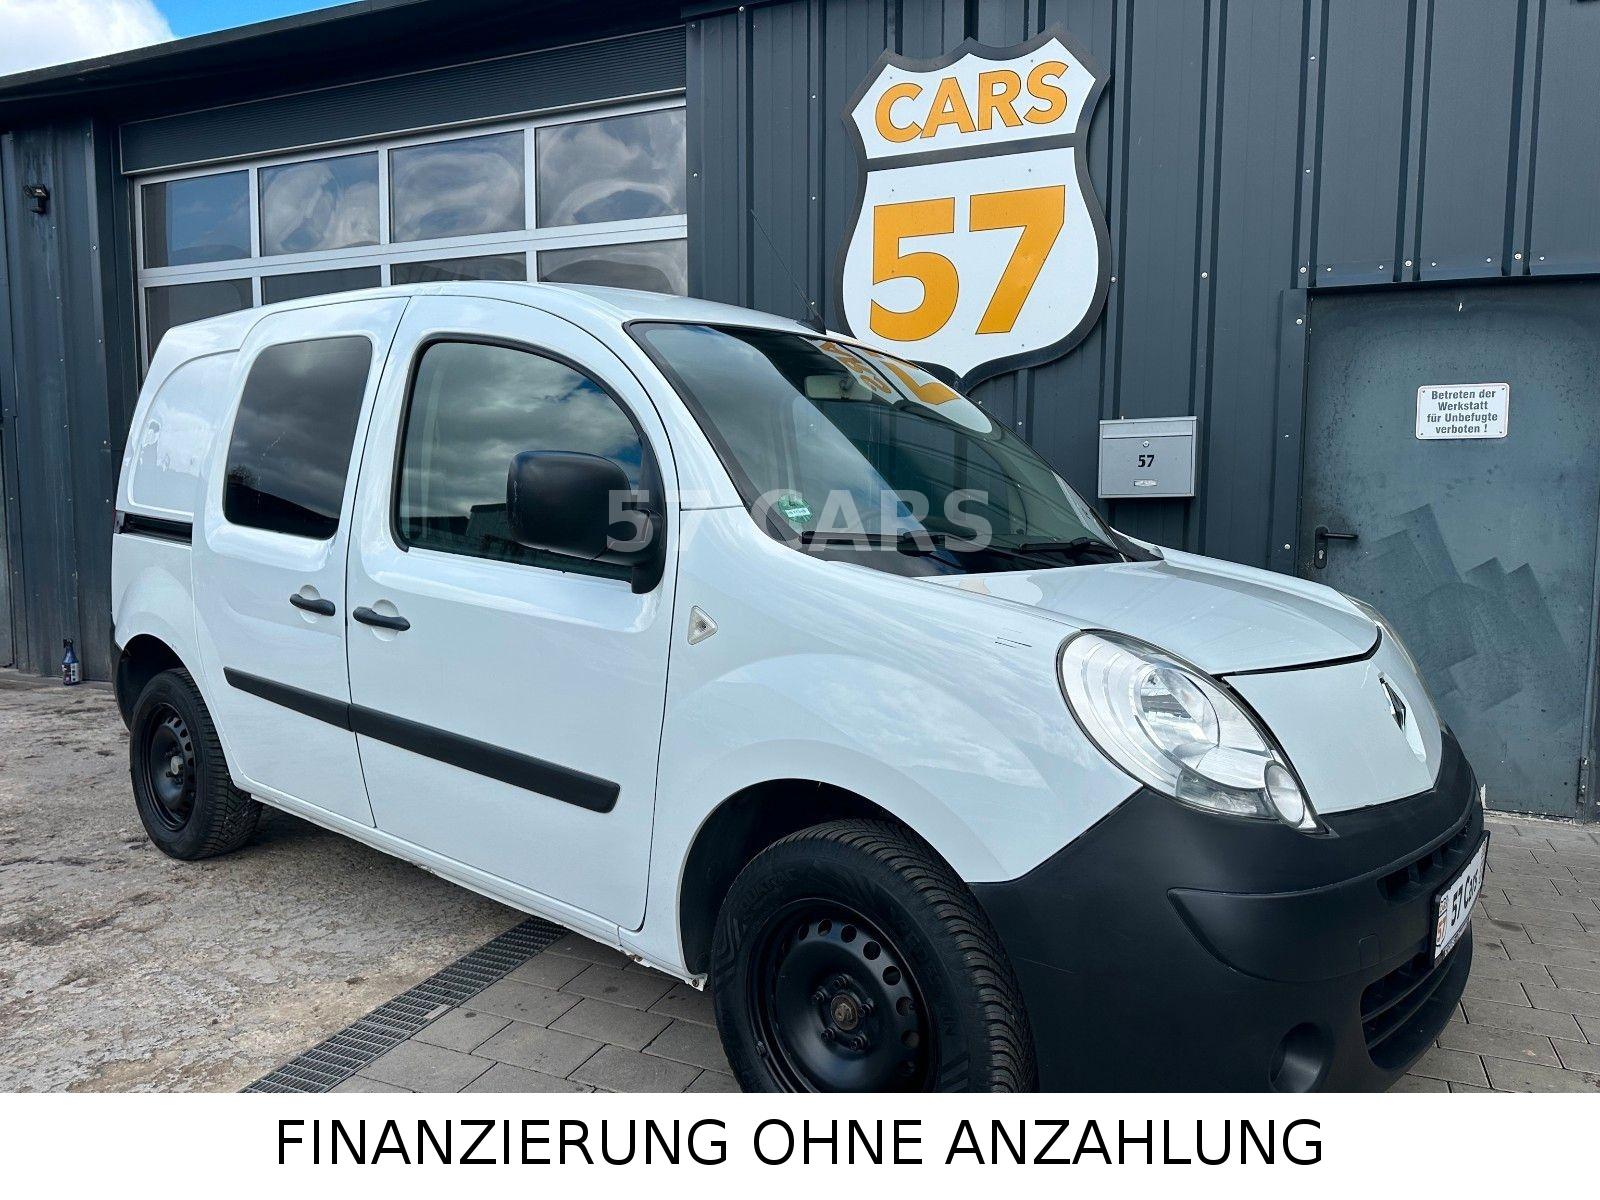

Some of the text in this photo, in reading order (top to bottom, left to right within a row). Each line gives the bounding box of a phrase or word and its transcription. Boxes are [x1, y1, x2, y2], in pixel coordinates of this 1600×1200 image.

[875, 61, 1069, 143] CARS
[869, 184, 1066, 342] 57
[1431, 389, 1496, 400] Betreten der
[1437, 401, 1488, 411] Werkstatt
[1426, 412, 1498, 423] für Unbefugte
[1435, 424, 1488, 434] verboten !
[1137, 454, 1155, 468] 57
[1451, 884, 1463, 927] 57
